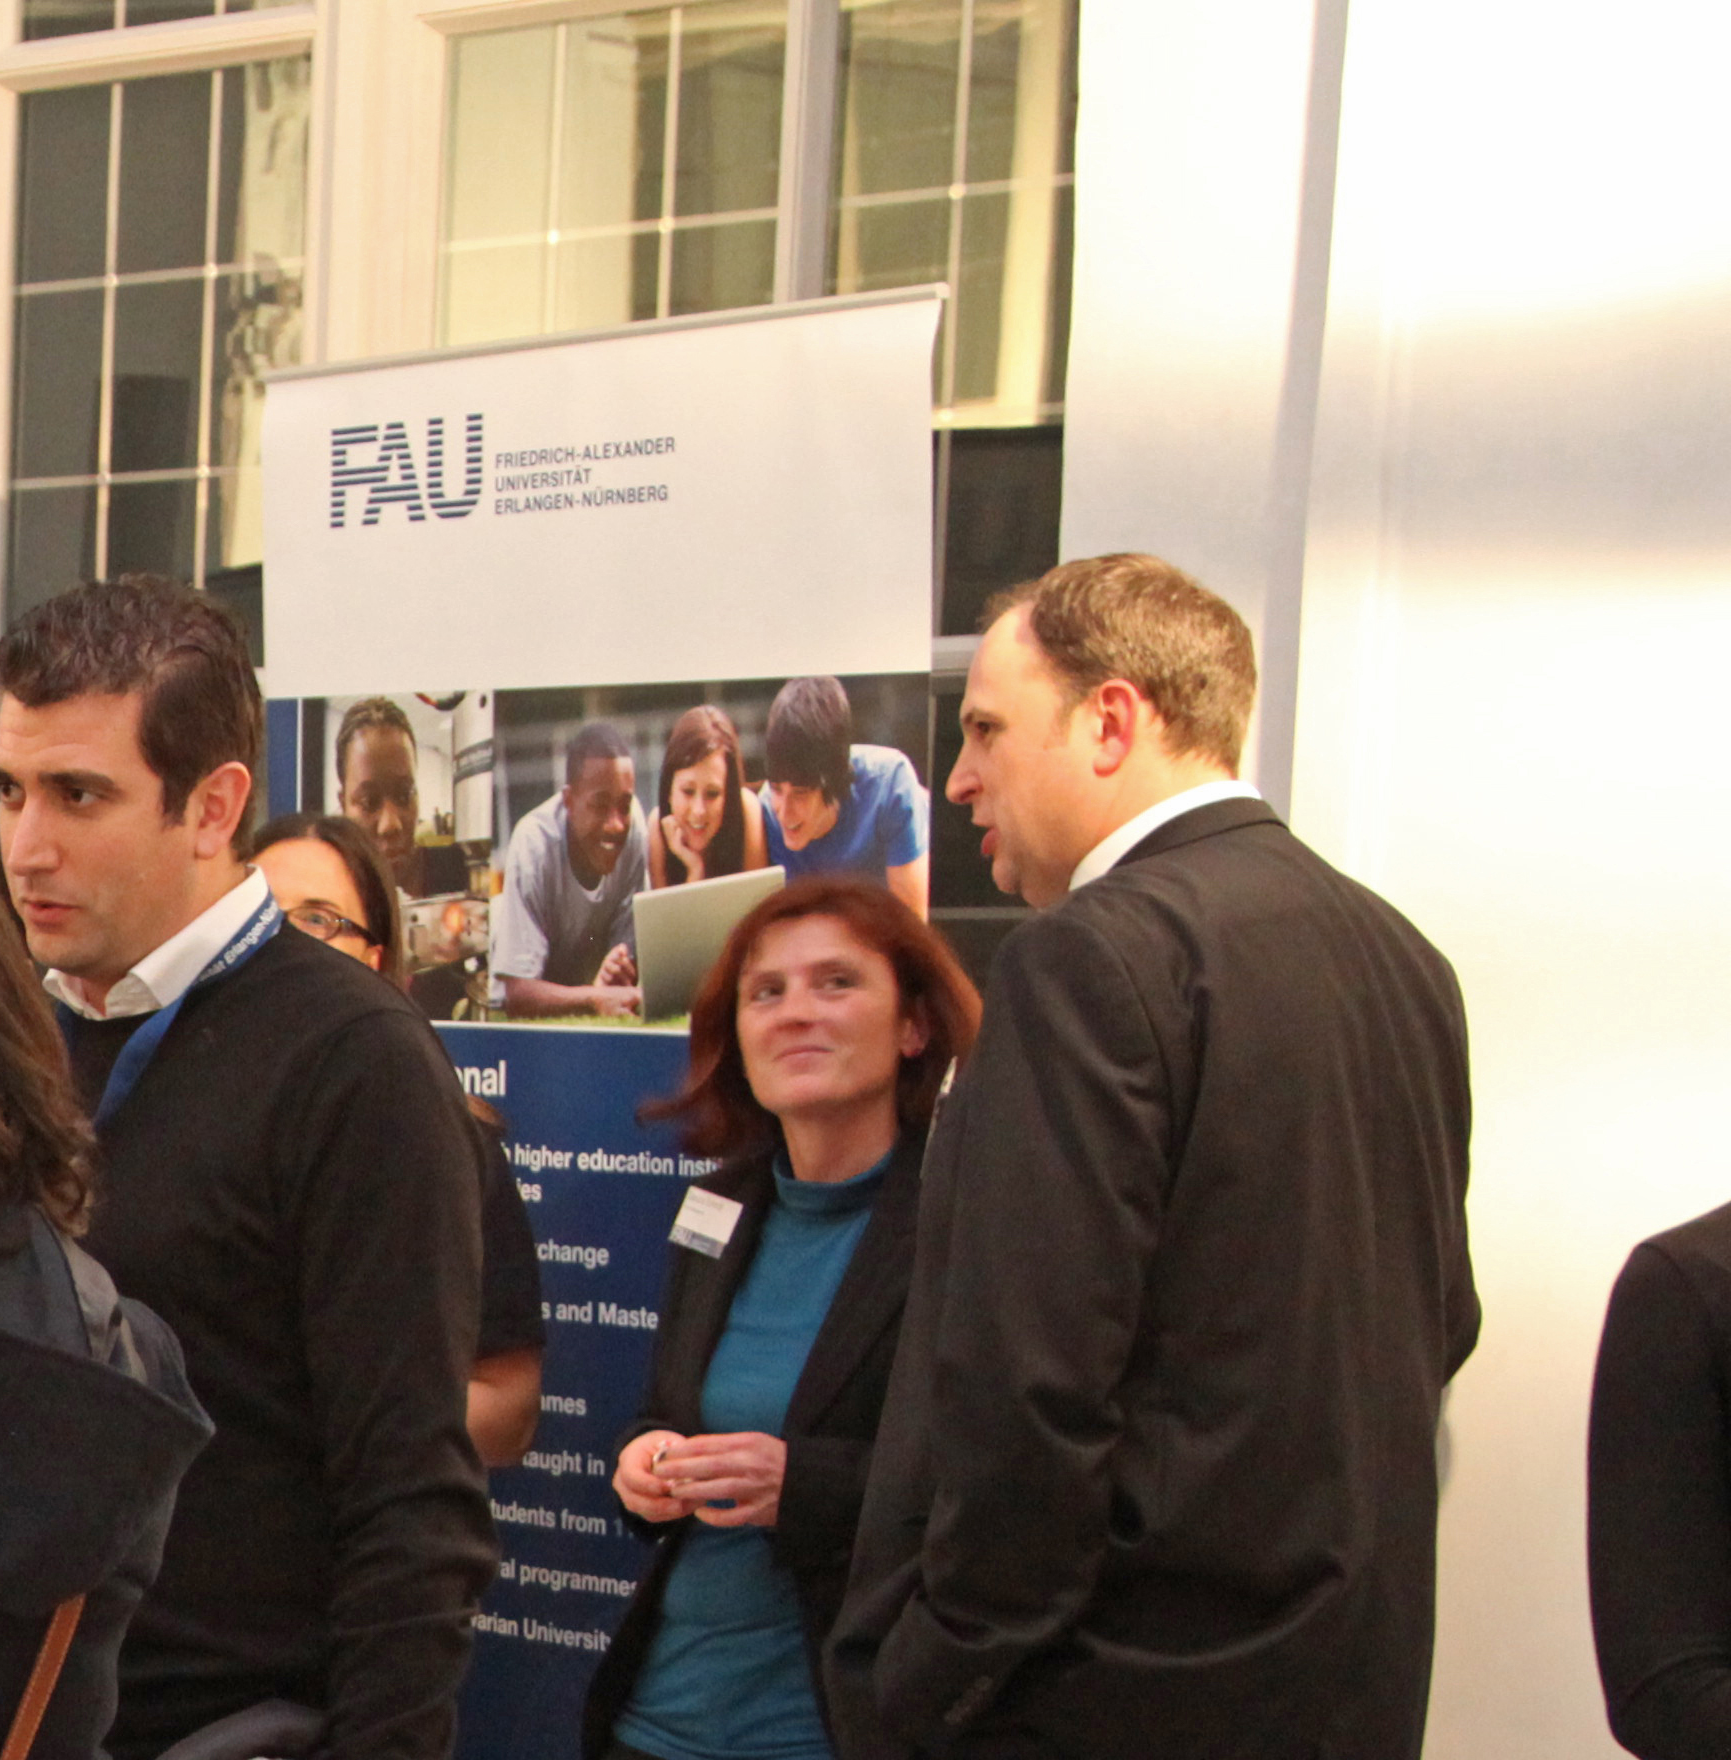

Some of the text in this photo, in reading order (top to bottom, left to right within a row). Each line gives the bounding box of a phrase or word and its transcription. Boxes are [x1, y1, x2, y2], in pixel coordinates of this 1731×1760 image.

[494, 436, 676, 469] FRIEDRICH-ALEXANDER
[329, 413, 484, 528] FAU
[494, 468, 593, 493] UNIVERSITÄT
[494, 485, 669, 515] ERLANGEN-NÜRNBERG
[514, 1144, 573, 1171] higher
[576, 1148, 674, 1174] education
[536, 1239, 610, 1270] change
[555, 1302, 593, 1323] and
[598, 1302, 659, 1330] Maste
[588, 1453, 606, 1476] in
[561, 1508, 606, 1535] from
